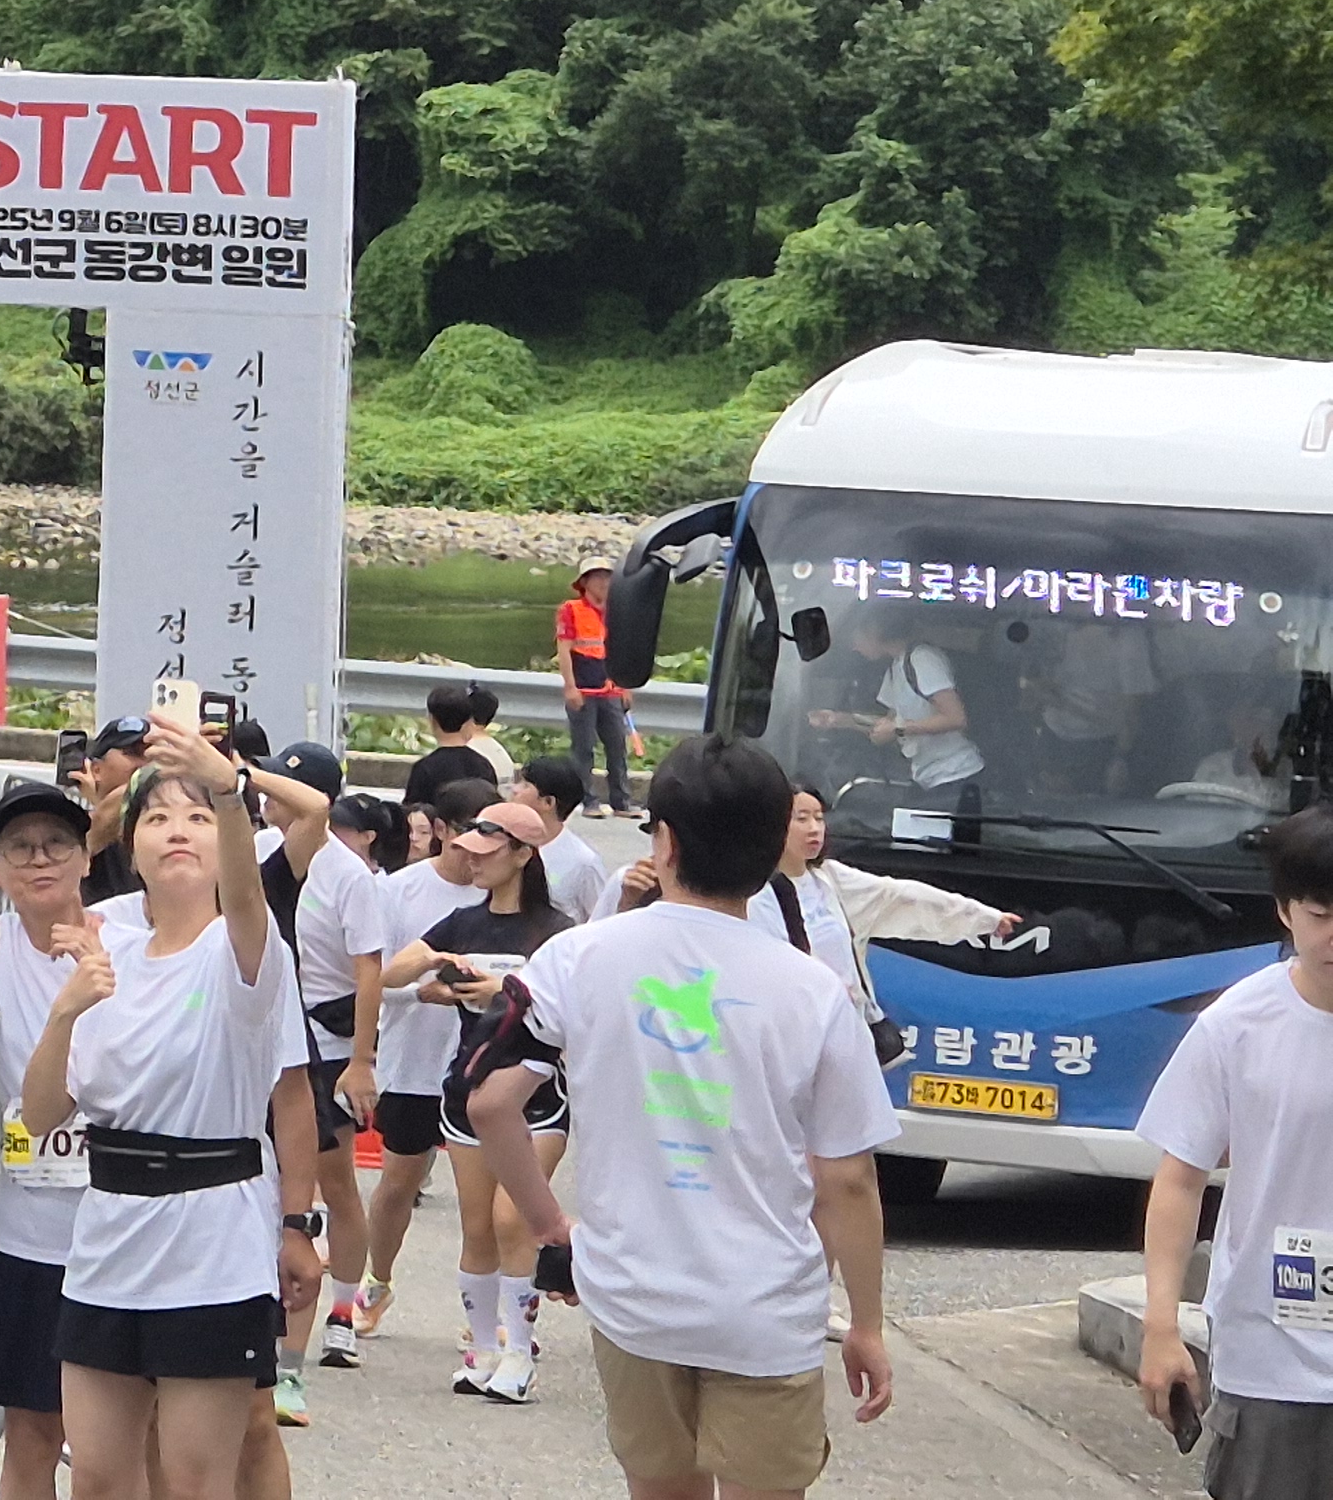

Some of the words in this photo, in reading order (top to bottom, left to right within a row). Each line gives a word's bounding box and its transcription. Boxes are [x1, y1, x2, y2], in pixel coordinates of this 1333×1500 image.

[57, 208, 100, 234] 9월
[83, 239, 214, 287] 동강변
[220, 245, 309, 290] 일원
[143, 379, 202, 403] 정선군
[229, 349, 268, 479] 시간을
[984, 1086, 1046, 1112] 7014
[1276, 1263, 1313, 1292] 10km
